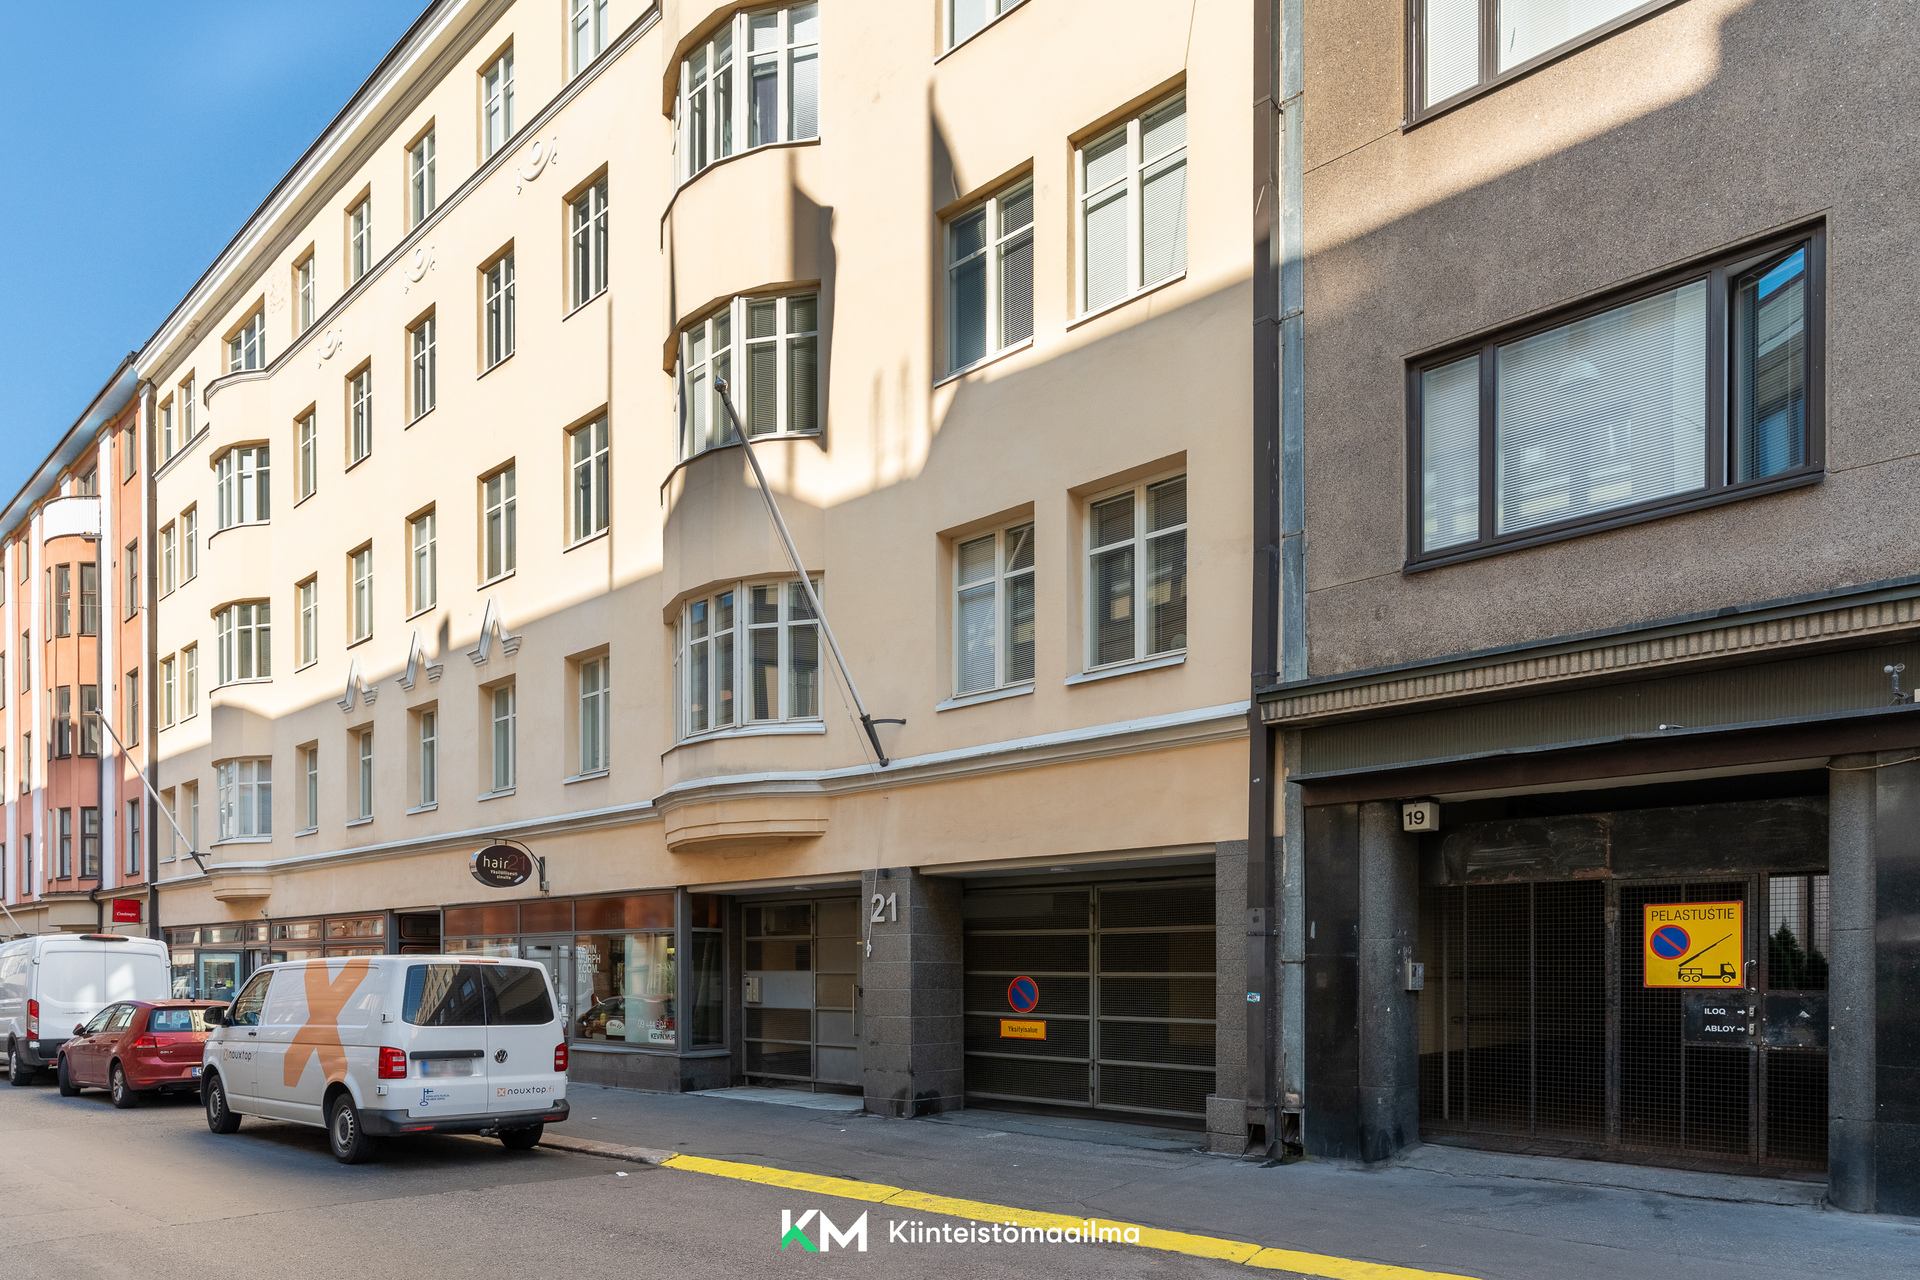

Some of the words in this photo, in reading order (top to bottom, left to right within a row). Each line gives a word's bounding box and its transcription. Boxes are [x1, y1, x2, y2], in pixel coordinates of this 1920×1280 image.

[1405, 810, 1425, 825] 19
[484, 855, 525, 870] hair21
[871, 892, 897, 922] 21
[1704, 1007, 1726, 1015] ILOQ
[1007, 1025, 1038, 1034] Yksityisalue
[228, 1049, 252, 1062] nouxtop
[507, 1085, 555, 1095] nouxtop.fi
